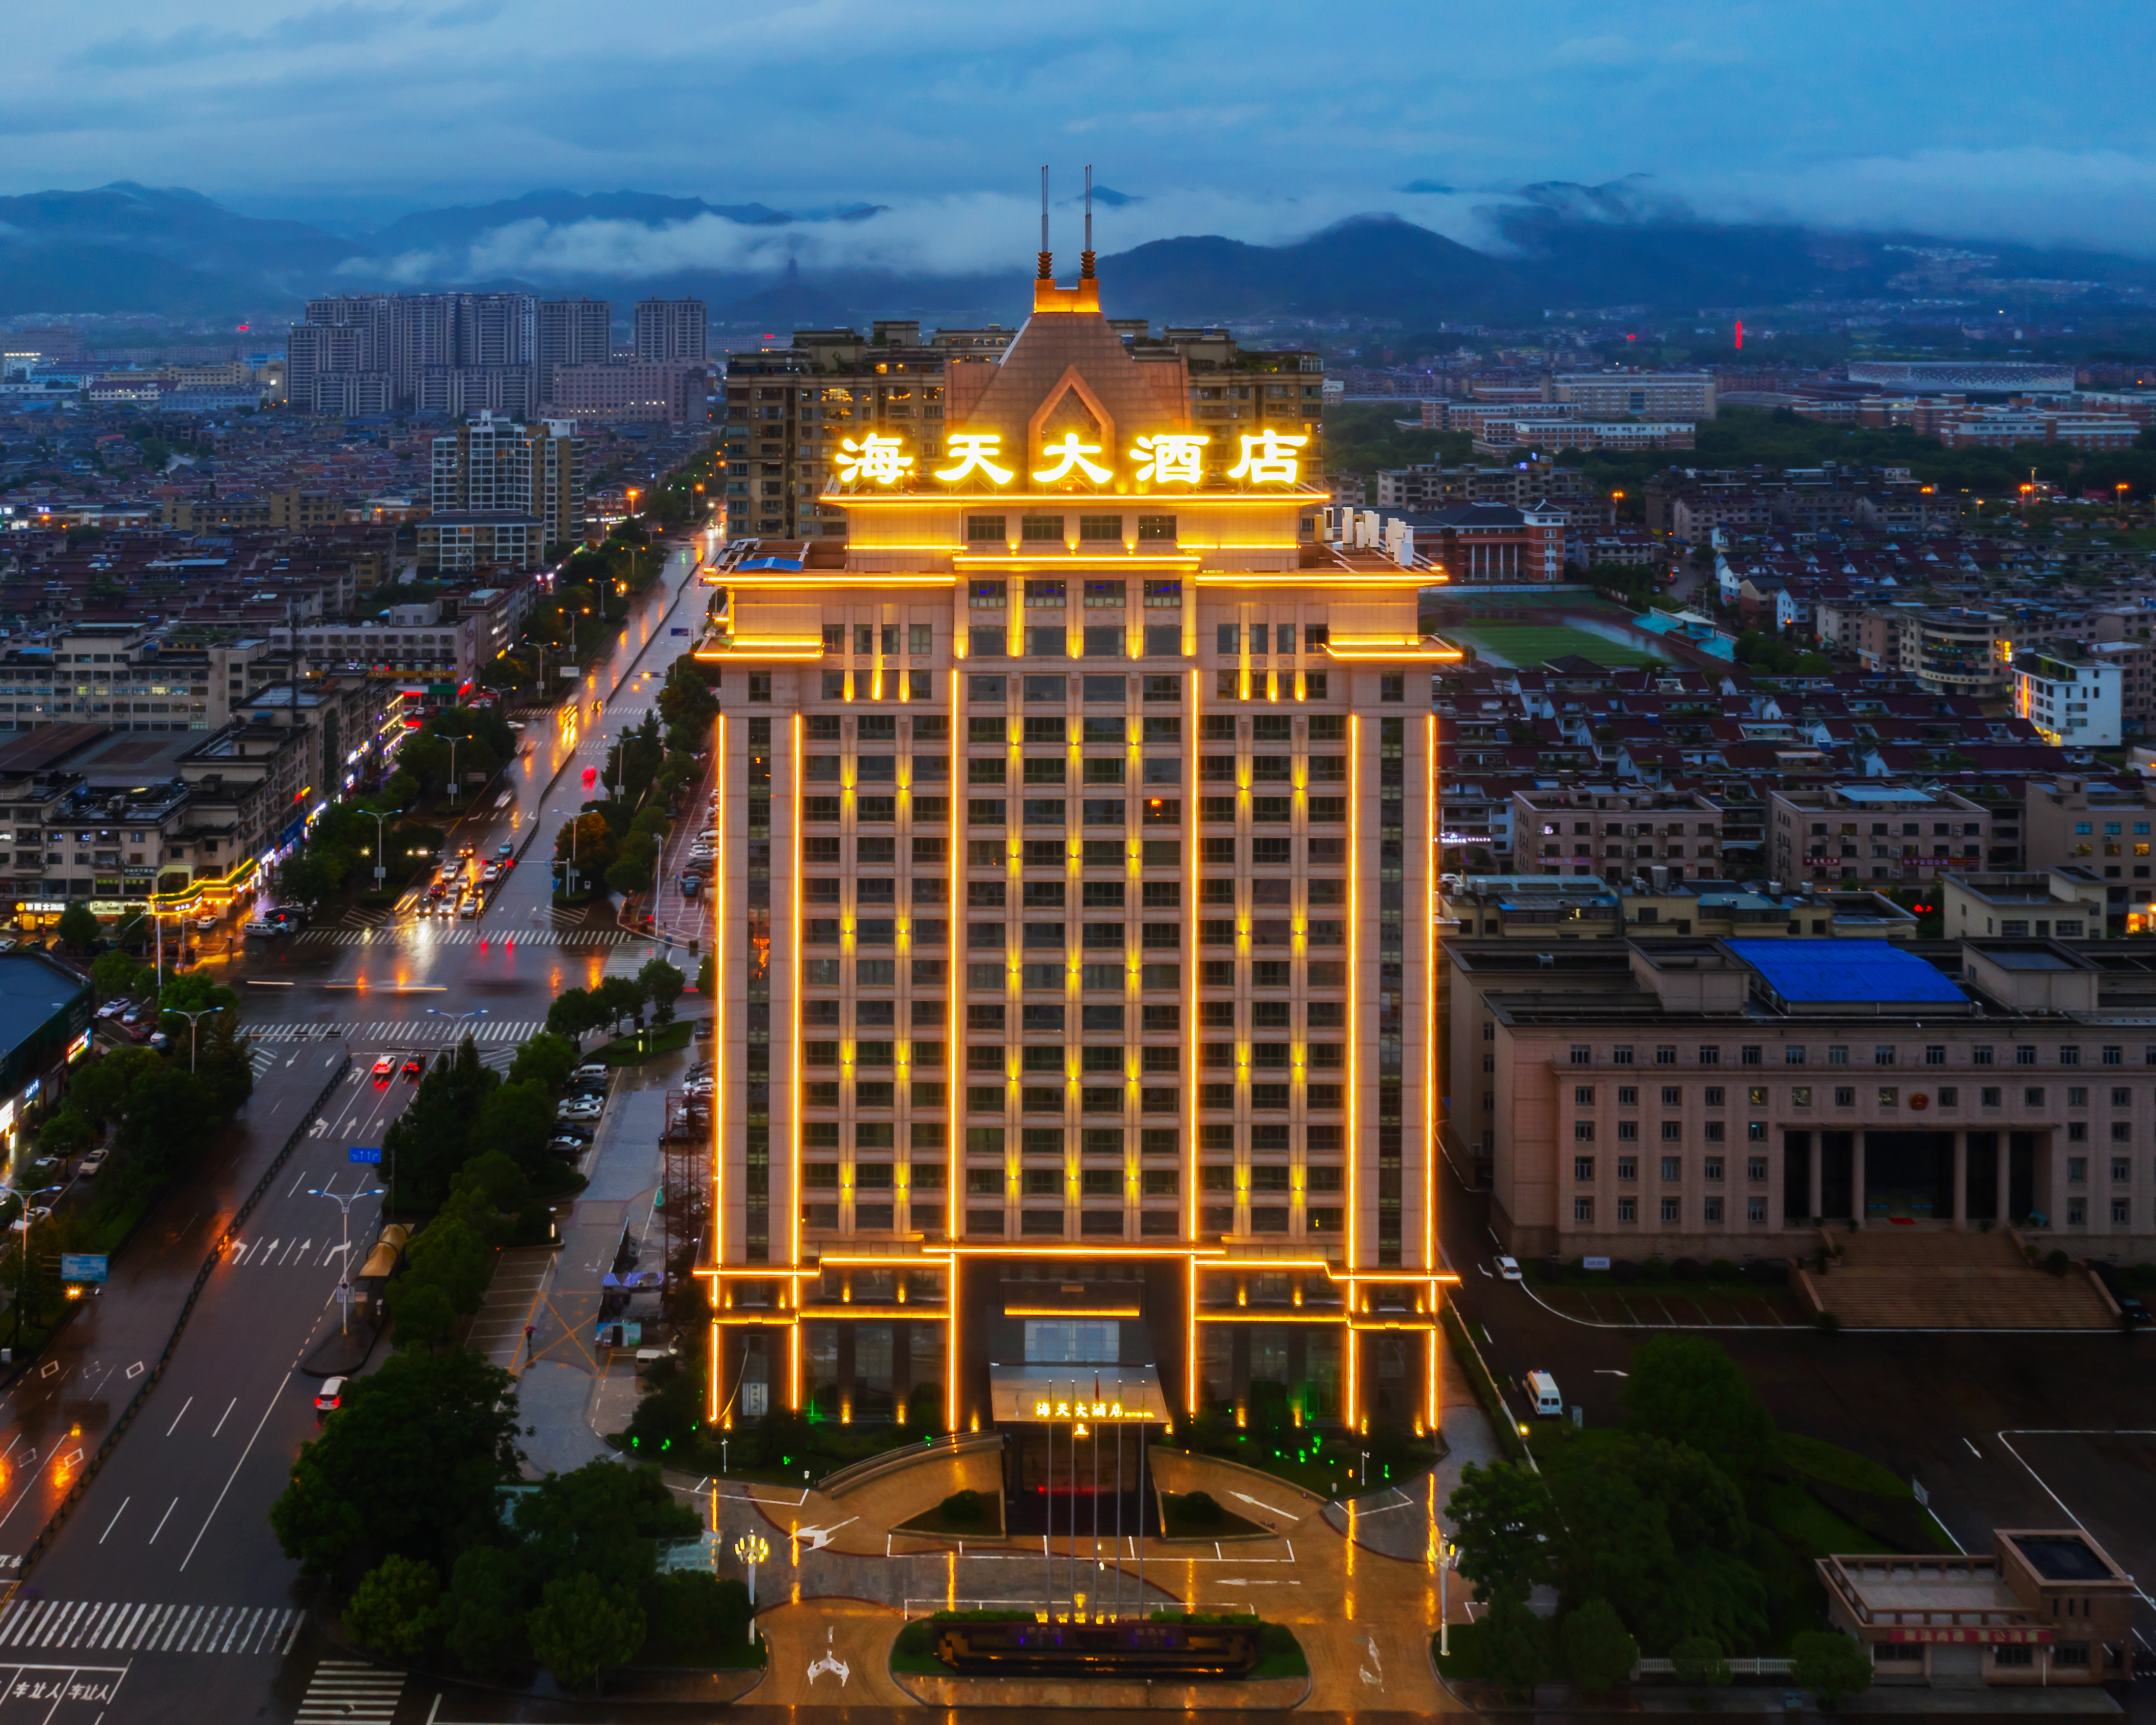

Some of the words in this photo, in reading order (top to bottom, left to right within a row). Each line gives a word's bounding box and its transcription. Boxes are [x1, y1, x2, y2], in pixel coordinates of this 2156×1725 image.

[835, 429, 1308, 484] 海天大酒店
[1036, 1402, 1123, 1418] 海天大酒店
[12, 1682, 61, 1699] 车让人
[68, 1683, 109, 1700] 车让人
